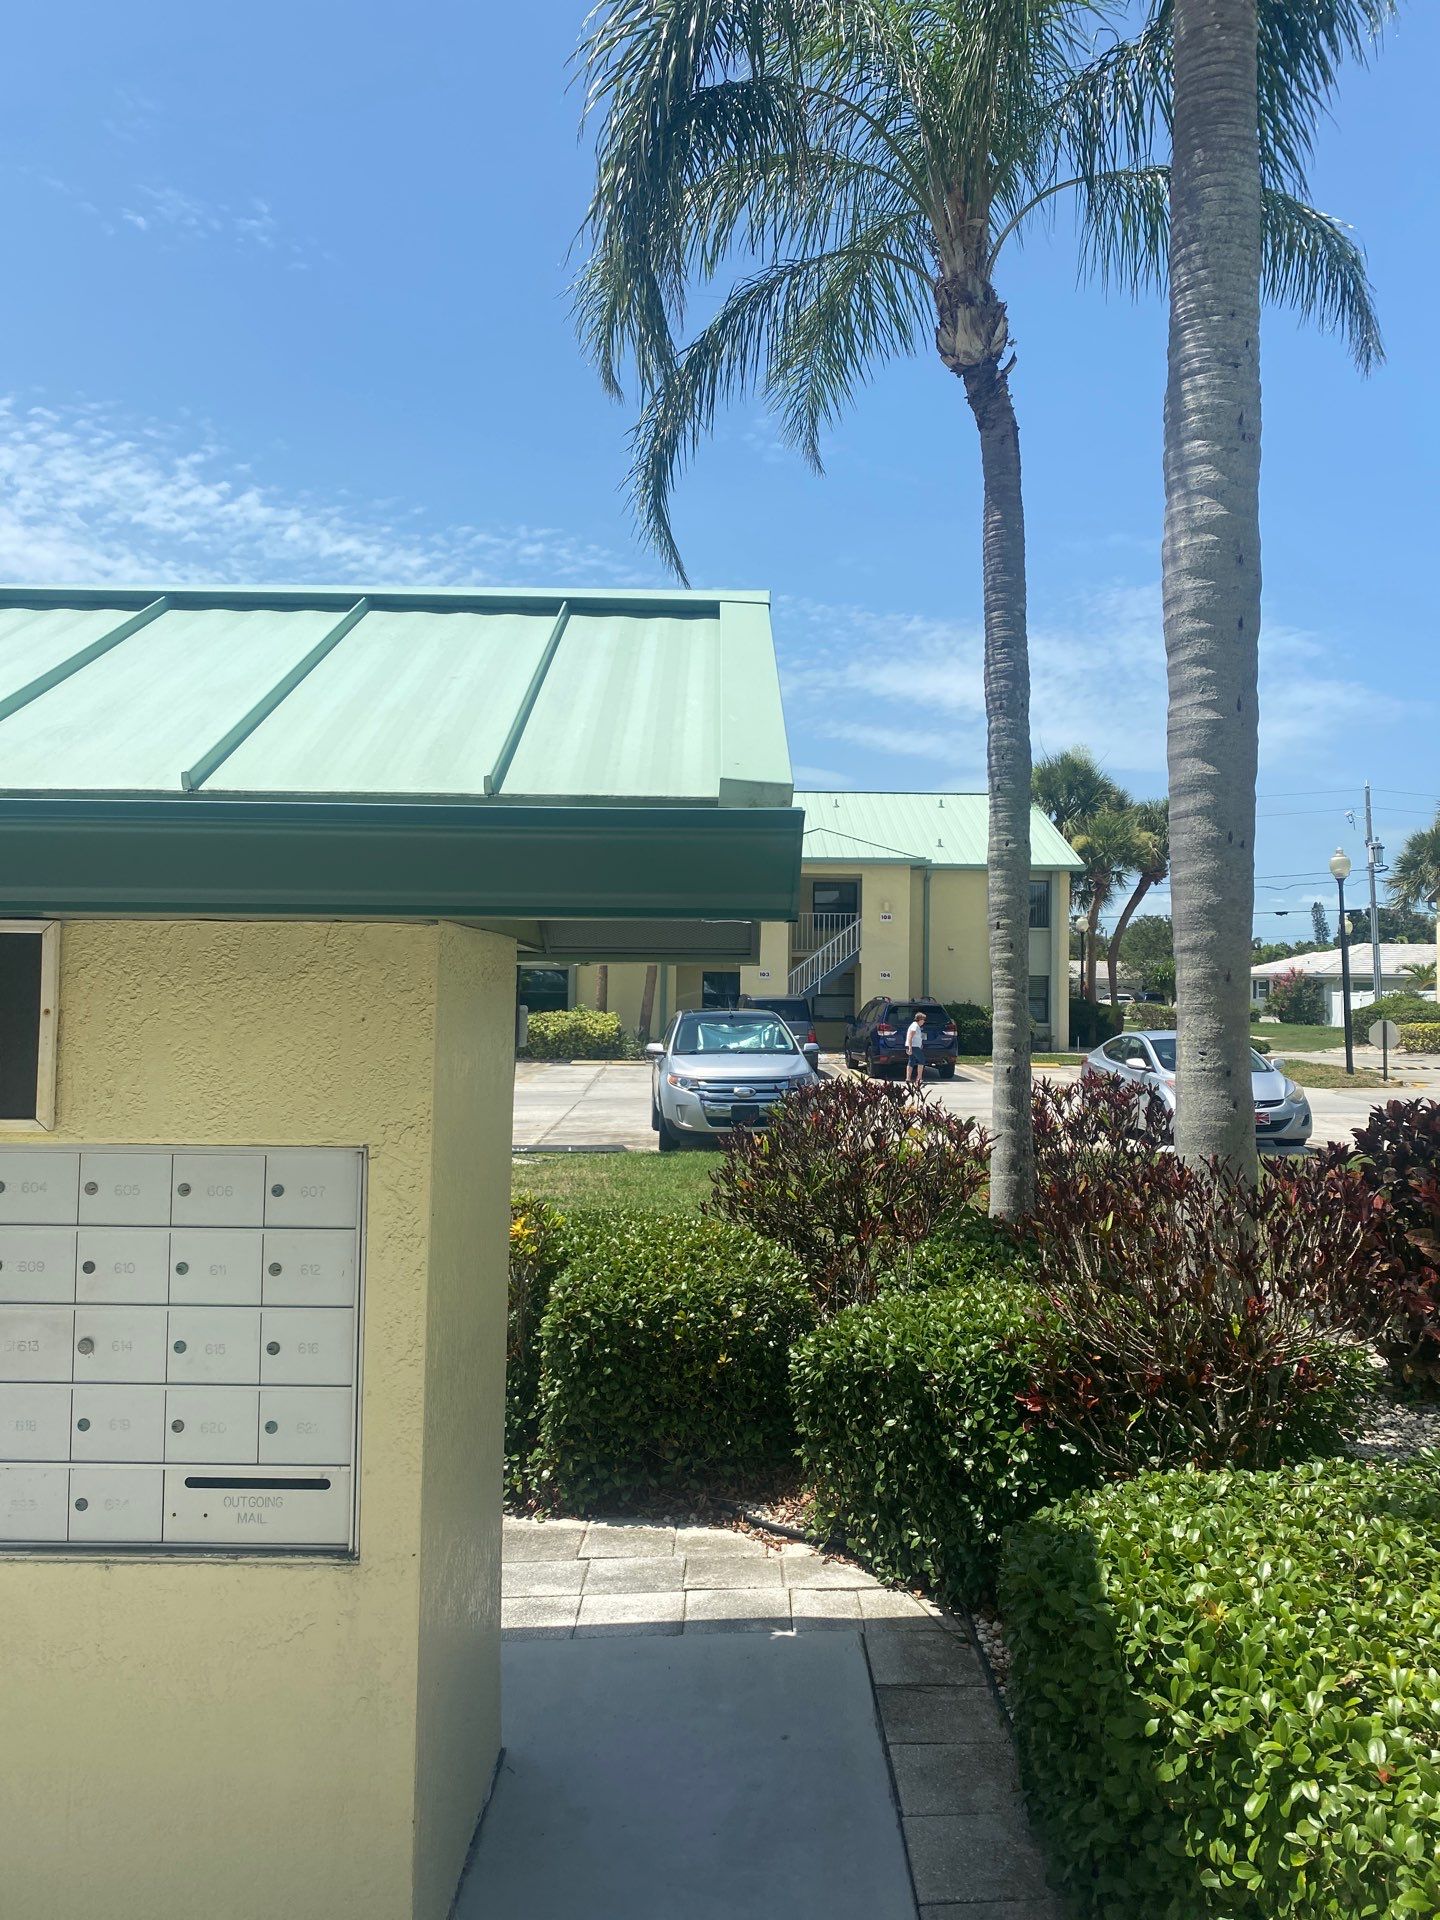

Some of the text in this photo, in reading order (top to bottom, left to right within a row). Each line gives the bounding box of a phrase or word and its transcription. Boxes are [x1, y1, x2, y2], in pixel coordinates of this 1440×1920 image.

[21, 1182, 47, 1193] 604
[114, 1184, 141, 1196] 605
[207, 1185, 233, 1197] 606
[300, 1186, 326, 1198] 607
[114, 1262, 136, 1274] 610
[209, 1264, 227, 1276] 611
[300, 1264, 321, 1276] 612
[111, 1340, 133, 1352] 614
[205, 1343, 226, 1355] 615
[223, 1496, 284, 1508] OUTGOING
[237, 1512, 268, 1524] MAIL
